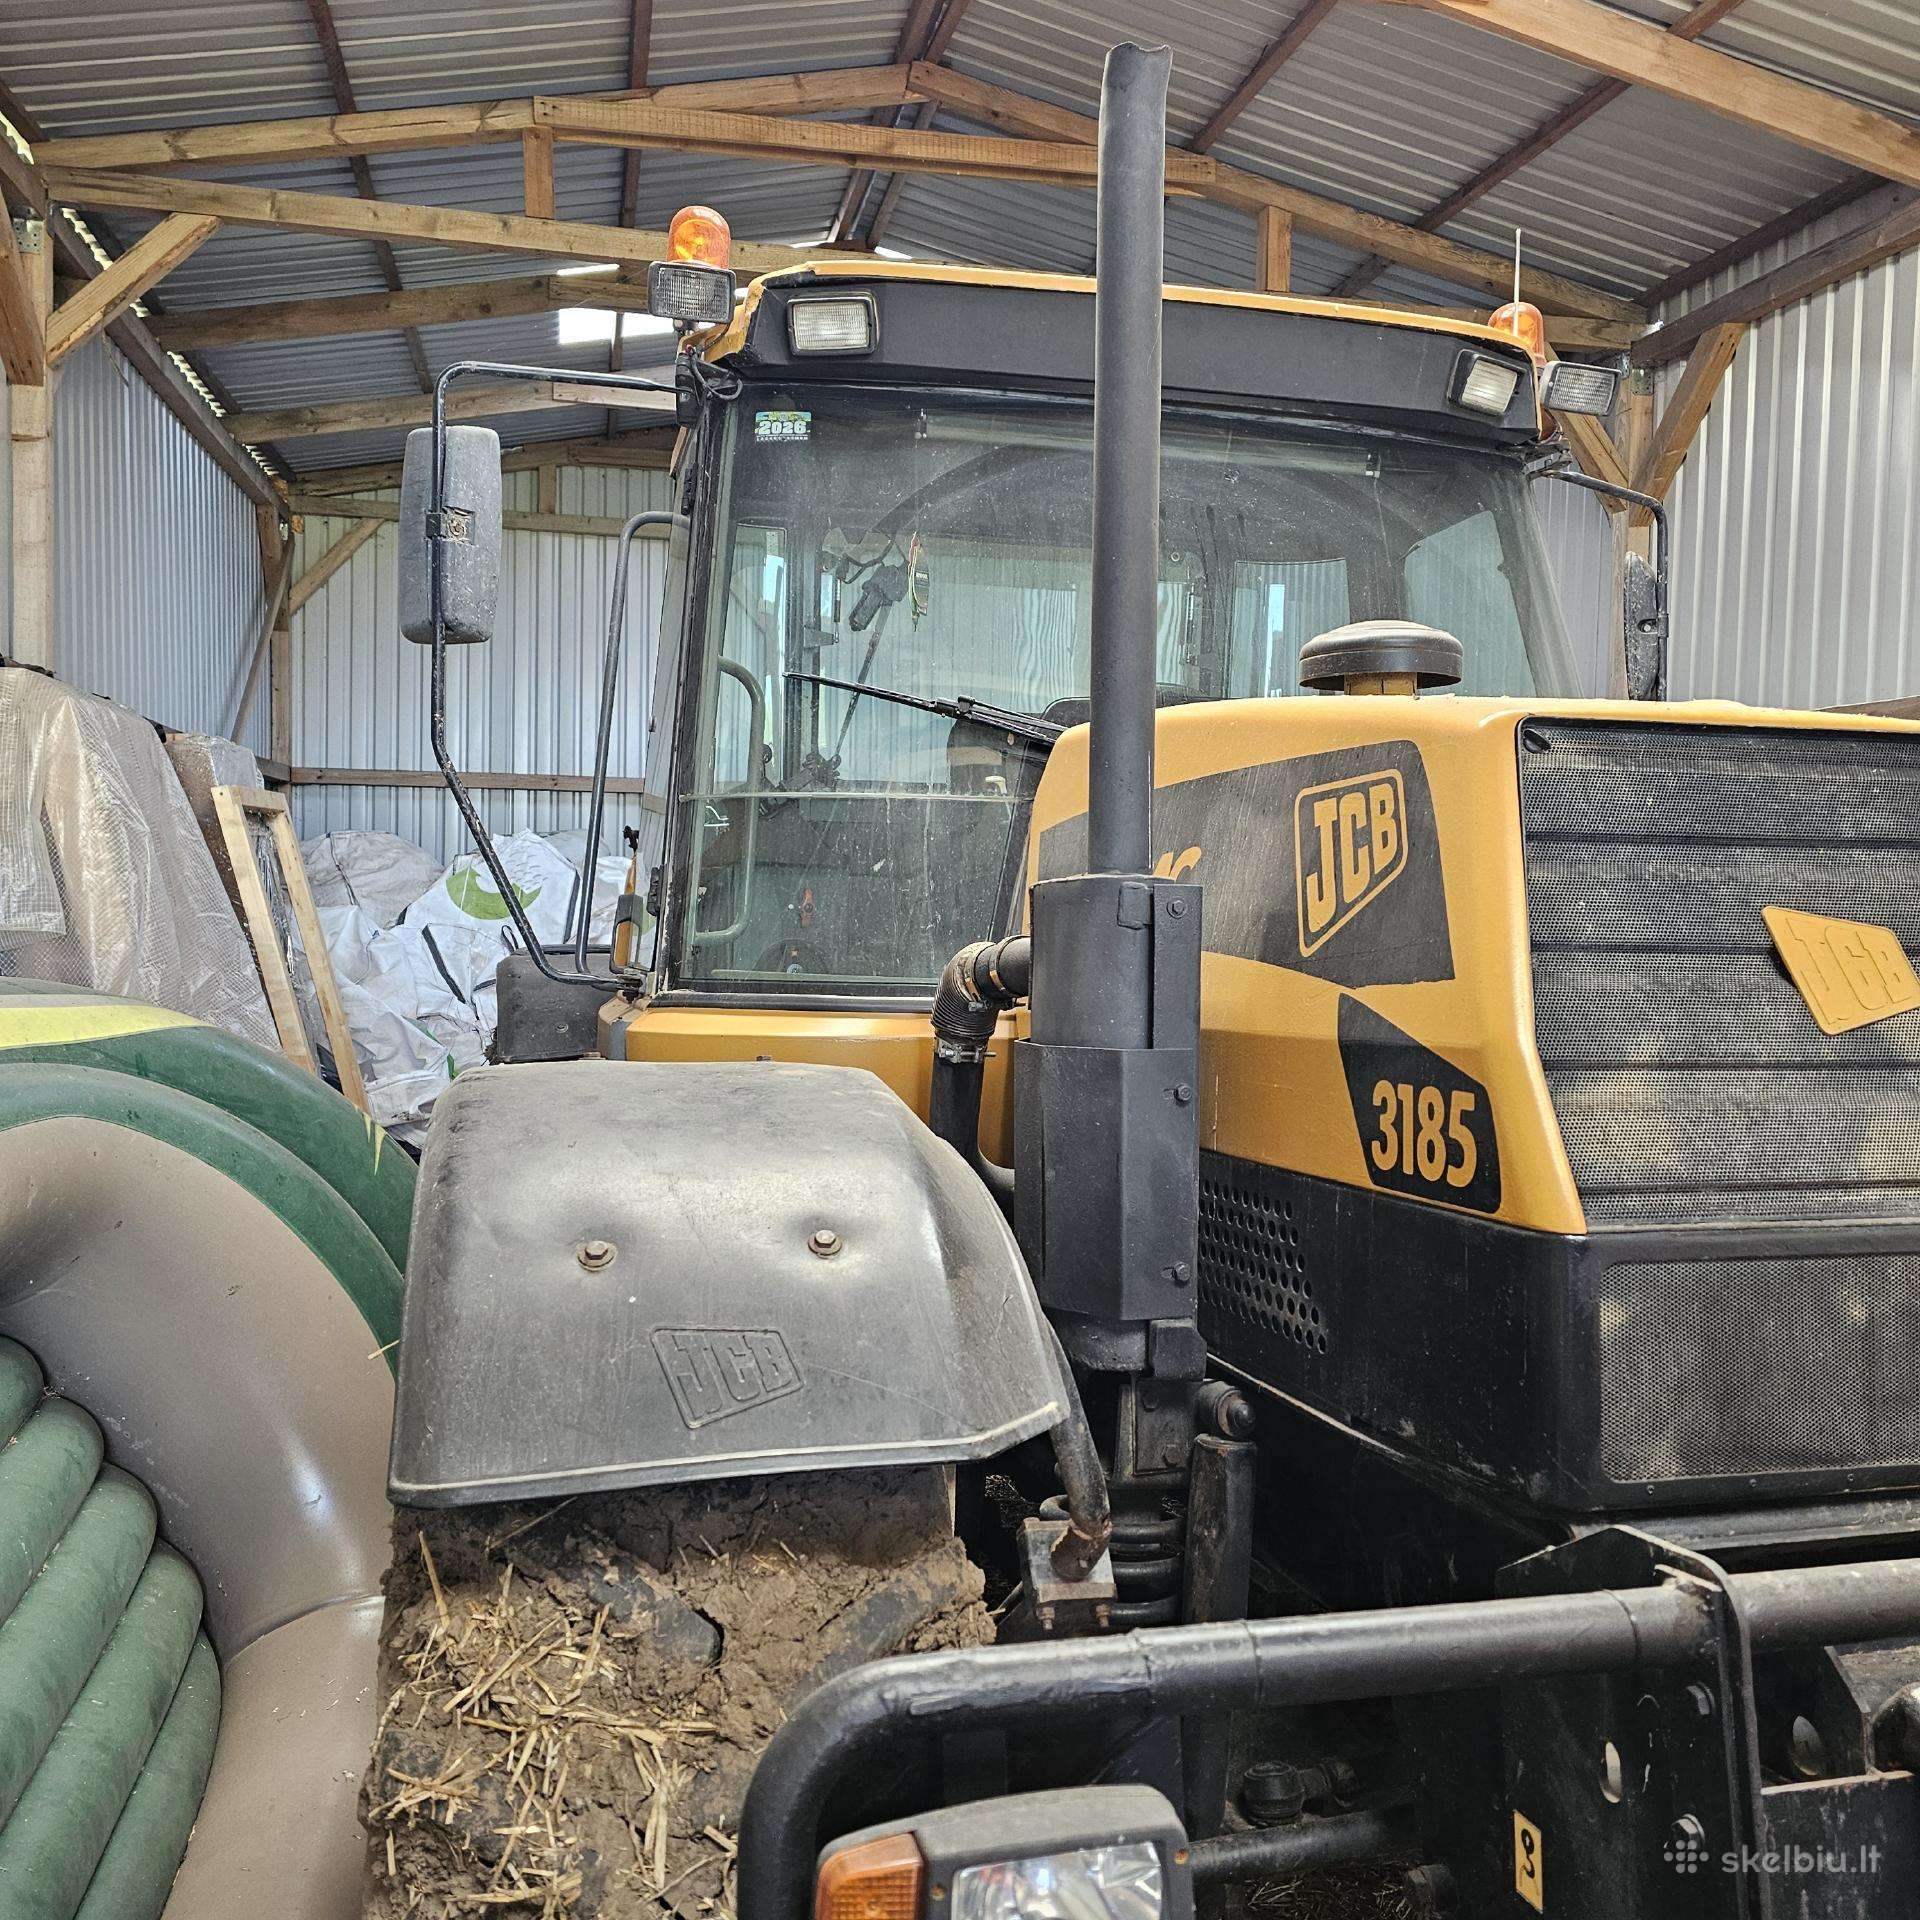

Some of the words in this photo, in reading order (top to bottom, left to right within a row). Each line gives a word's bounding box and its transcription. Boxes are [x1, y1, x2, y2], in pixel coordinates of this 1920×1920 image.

[758, 420, 807, 435] 2026
[1306, 785, 1397, 932] JCB
[1784, 915, 1915, 1026] JCB
[1371, 1079, 1478, 1188] 3185
[670, 1333, 795, 1421] JCB
